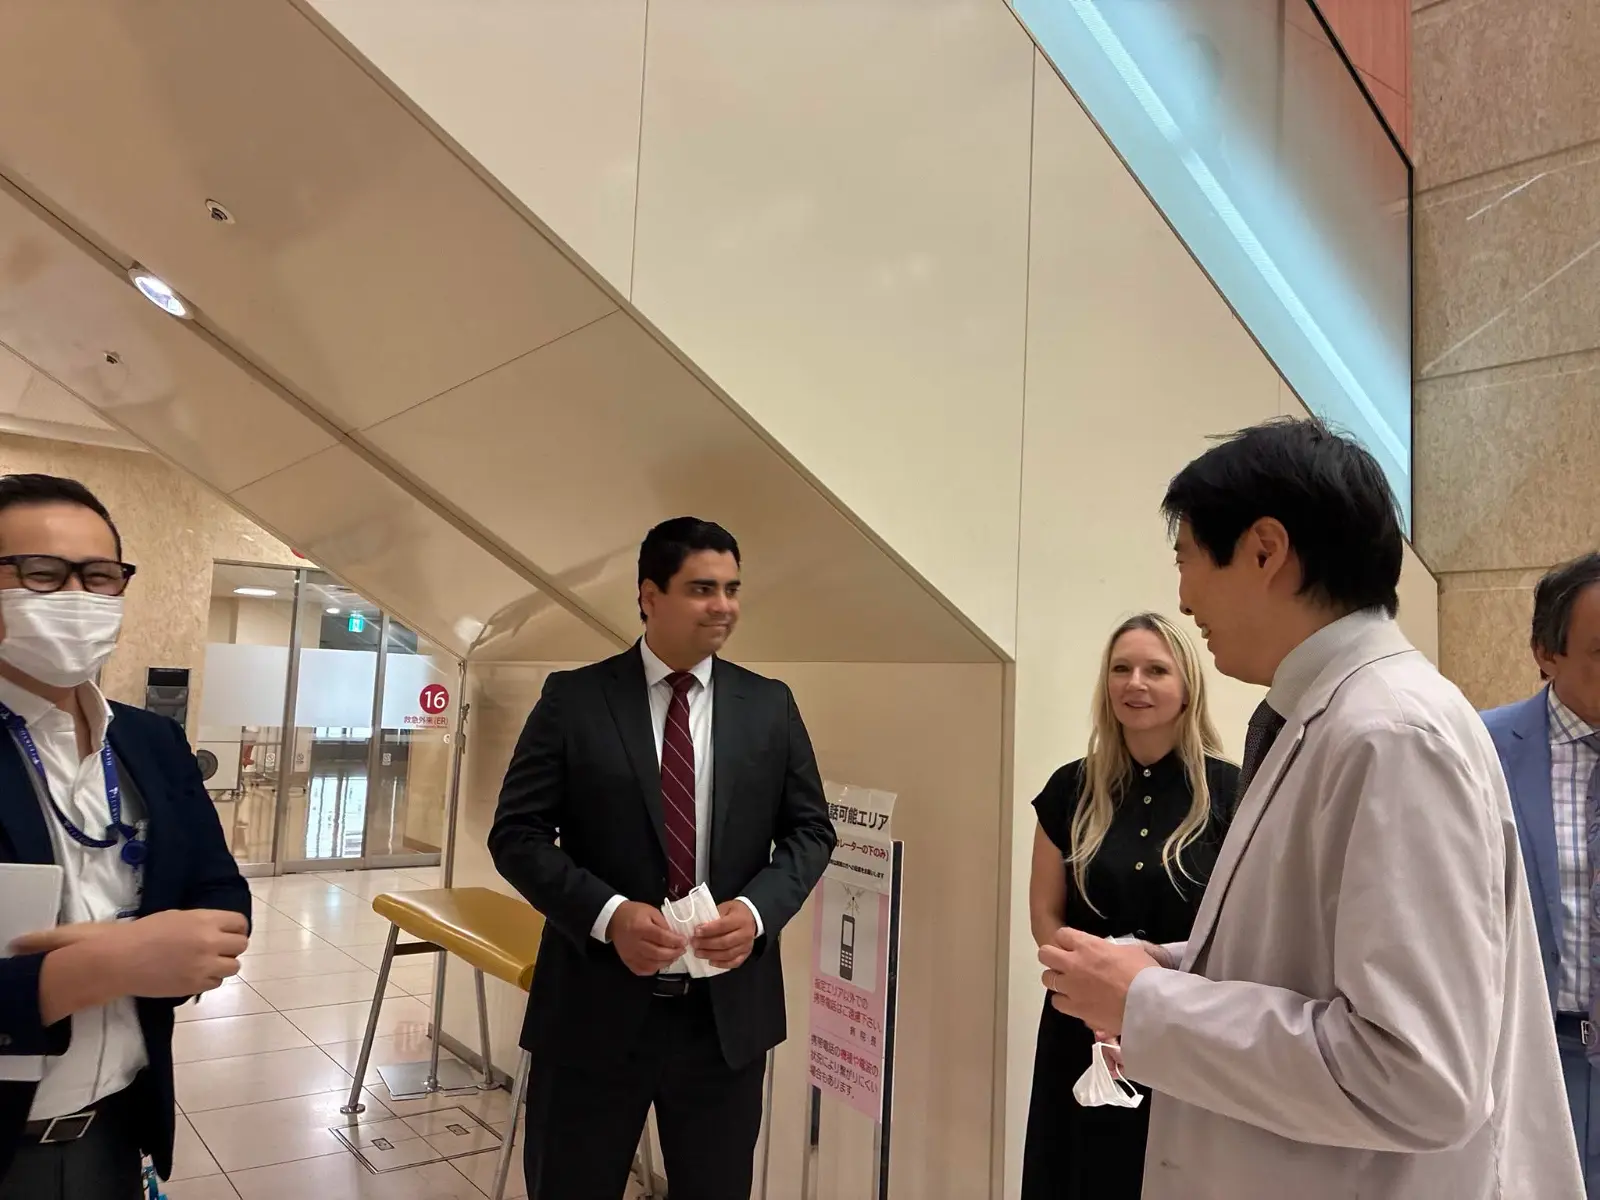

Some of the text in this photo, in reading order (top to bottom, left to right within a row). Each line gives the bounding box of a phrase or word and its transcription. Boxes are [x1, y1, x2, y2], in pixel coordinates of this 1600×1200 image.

[425, 691, 446, 709] 16
[827, 803, 889, 830] 話可能エリア
